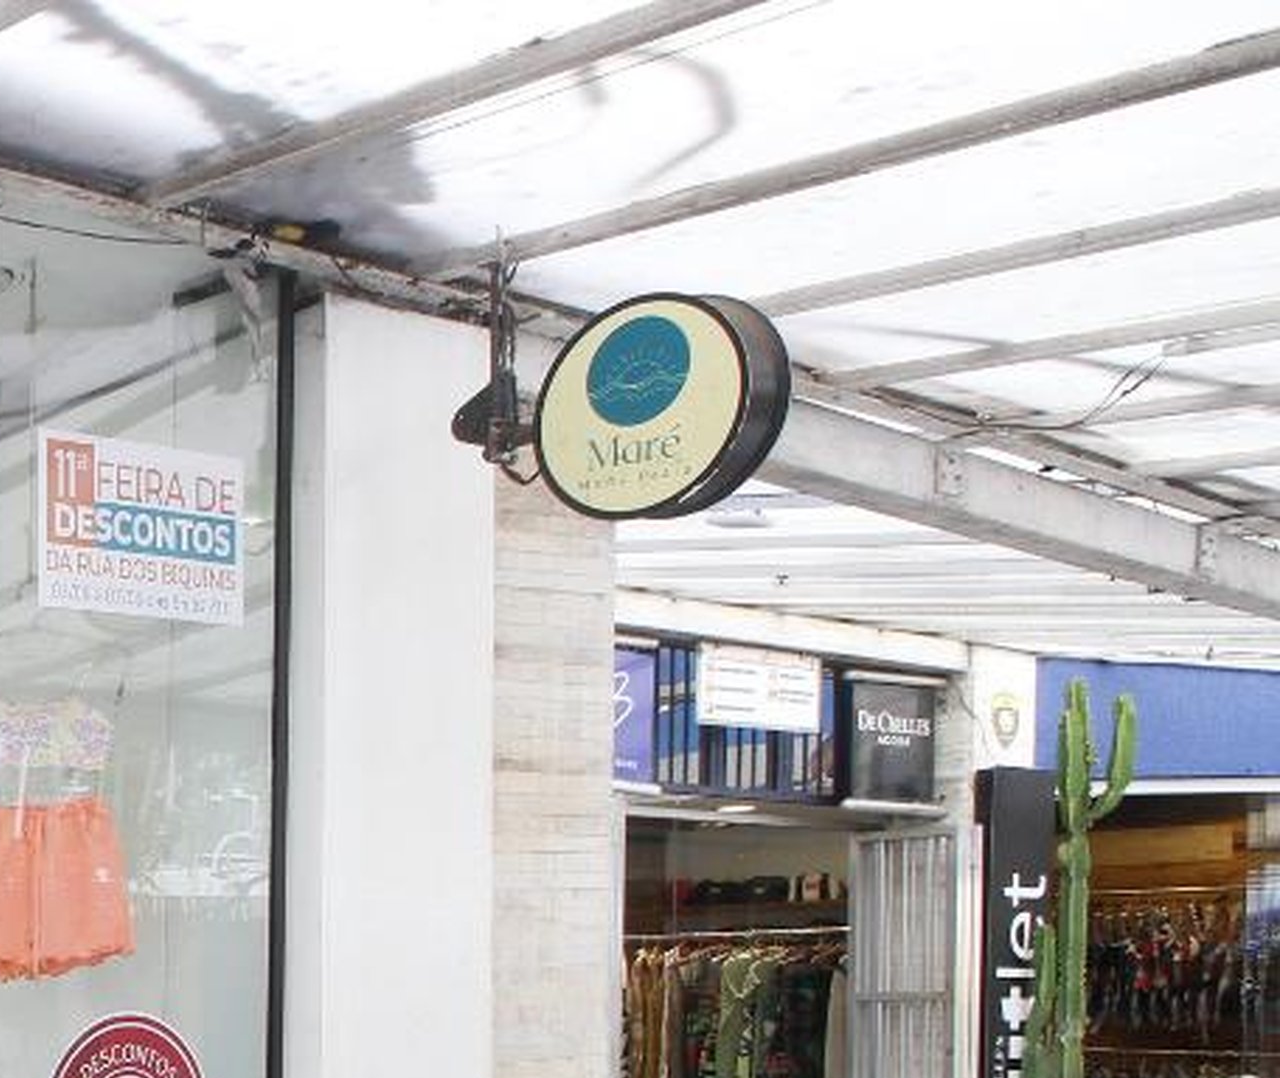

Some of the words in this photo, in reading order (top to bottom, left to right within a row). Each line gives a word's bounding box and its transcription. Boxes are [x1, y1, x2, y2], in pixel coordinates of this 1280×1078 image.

[588, 422, 681, 472] Maré
[97, 461, 186, 509] FEIRA
[196, 475, 237, 515] DE
[53, 502, 232, 558] DESCONTOS
[46, 549, 73, 573] DA
[77, 552, 116, 578] RUA
[120, 557, 158, 583] DOS
